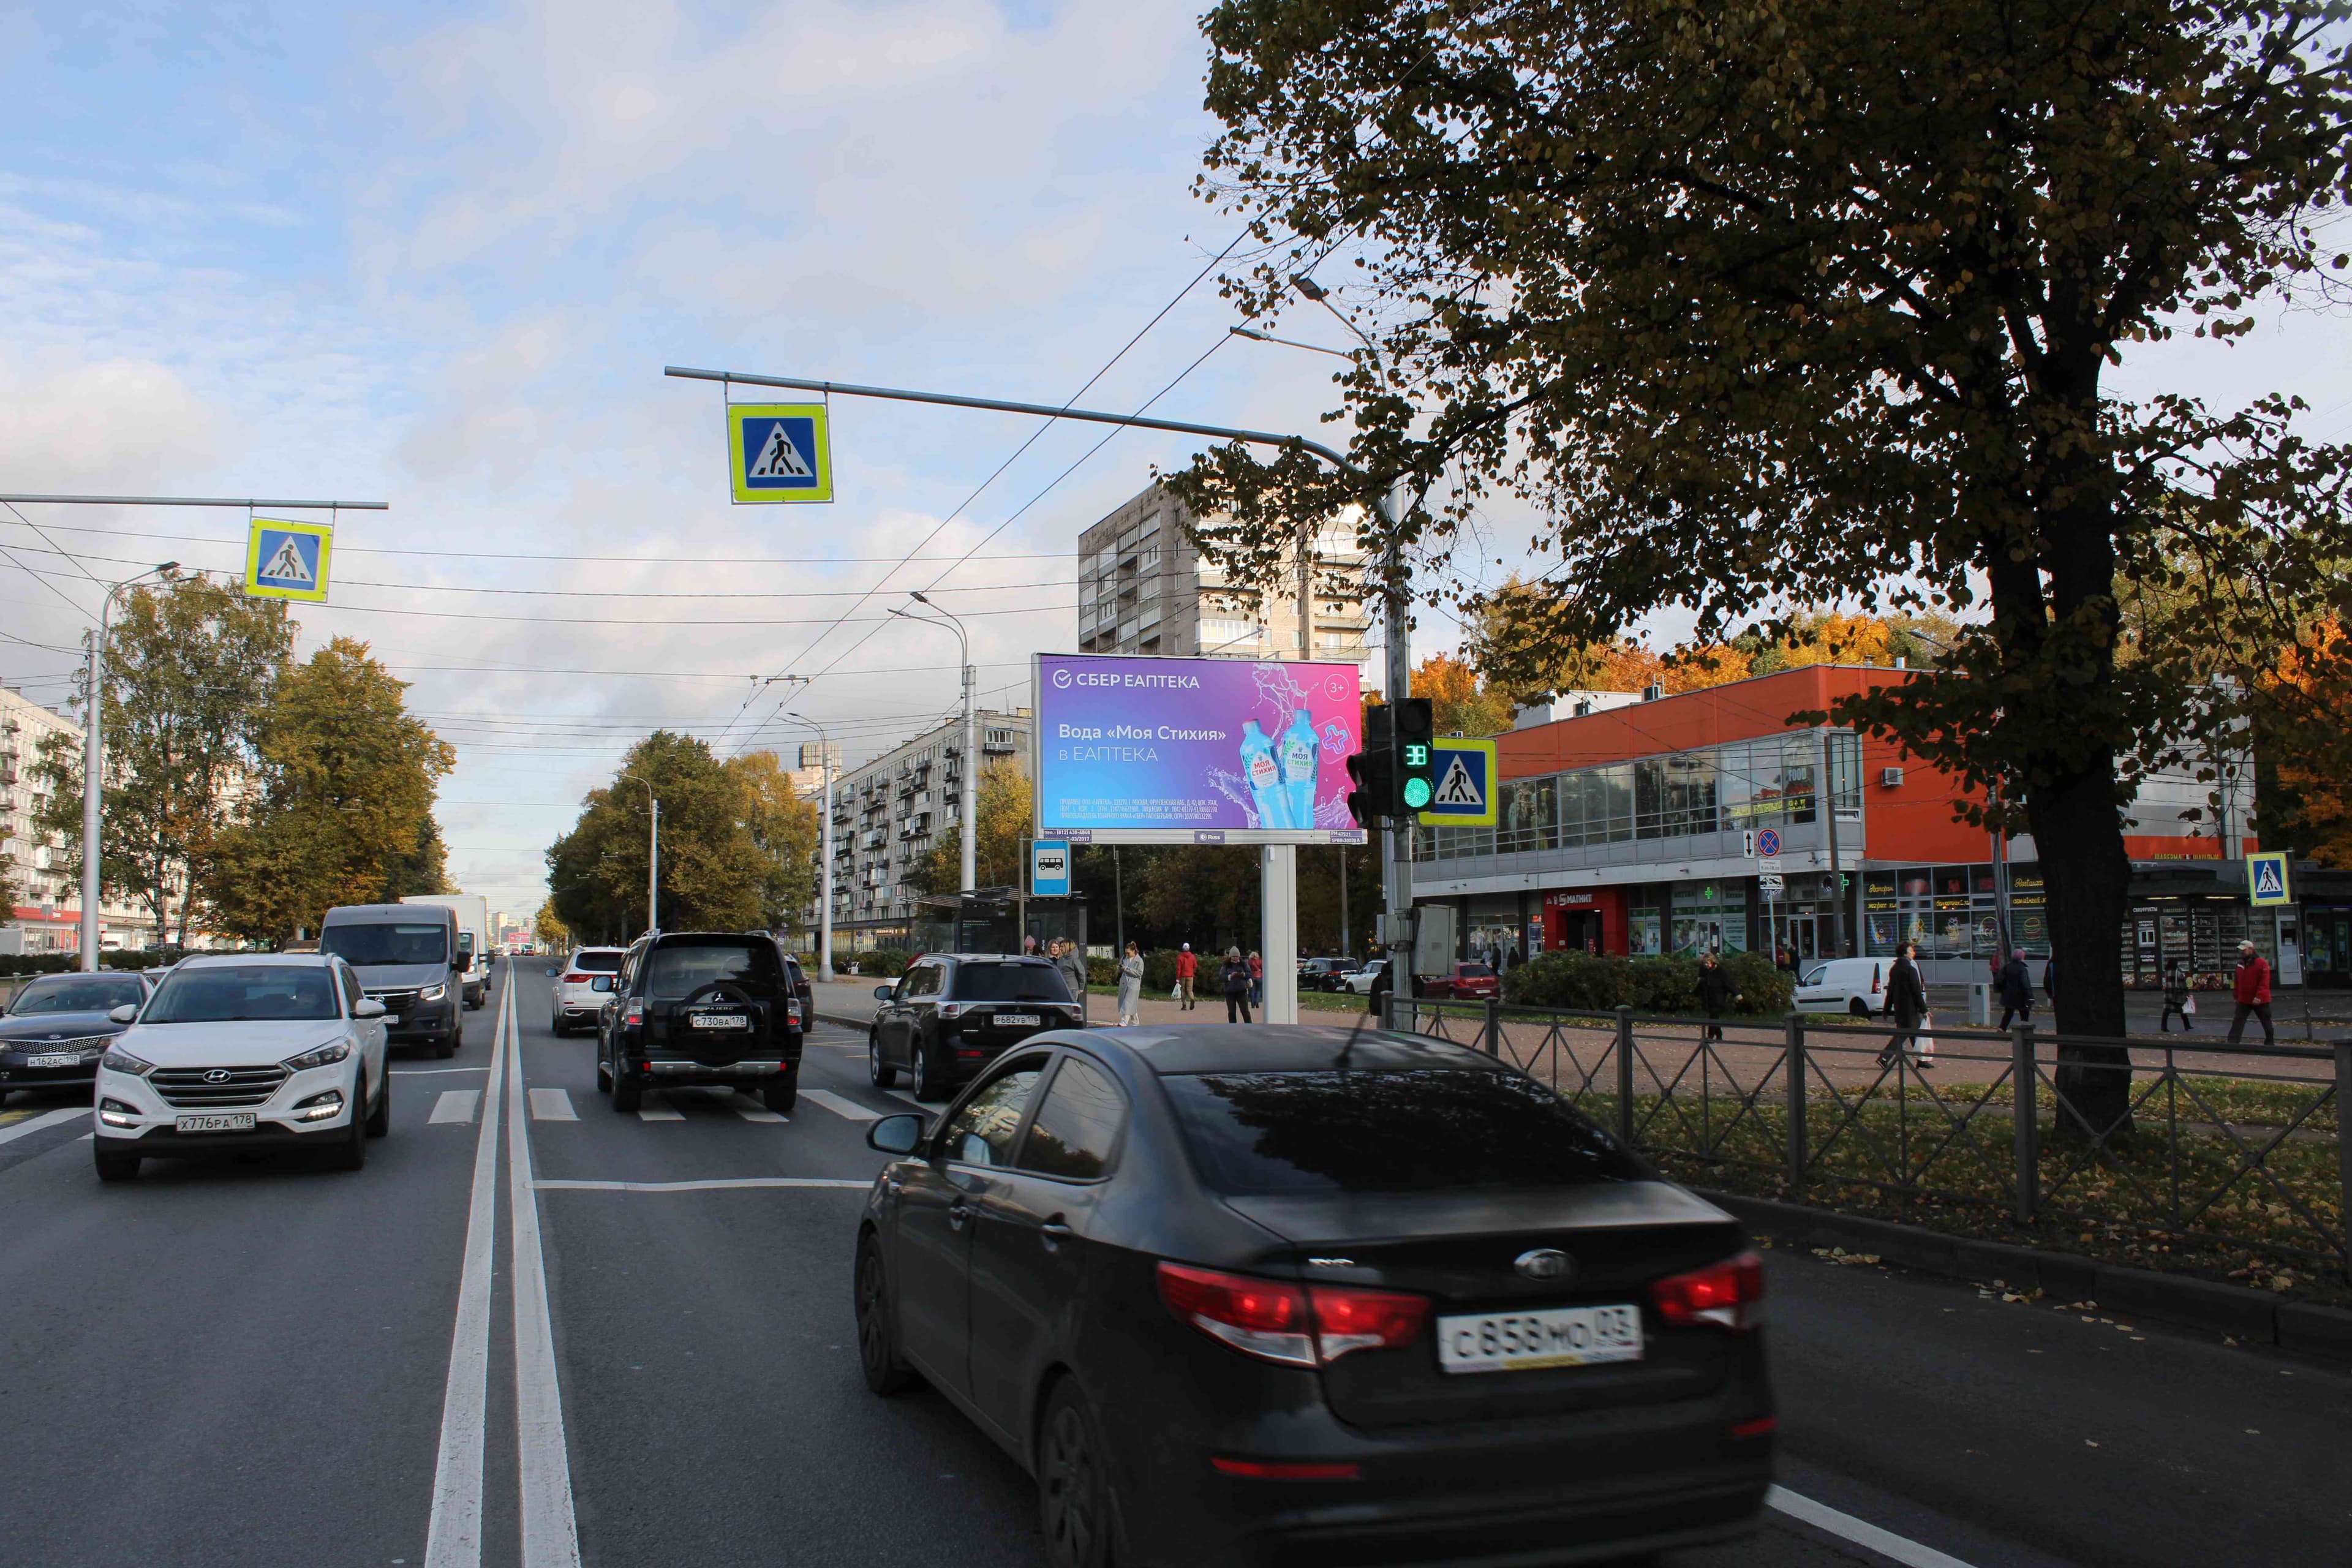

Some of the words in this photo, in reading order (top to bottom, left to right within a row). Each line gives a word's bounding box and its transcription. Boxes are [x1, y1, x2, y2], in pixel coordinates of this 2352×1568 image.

[1076, 674, 1120, 687] СБЕР
[1125, 674, 1200, 688] ЕАПТЕКА
[1330, 682, 1344, 693] 3+
[1059, 724, 1101, 741] Вода
[1107, 725, 1152, 739] «Моя
[1158, 726, 1226, 741] Стихия»
[1059, 750, 1068, 760] в
[1074, 747, 1158, 762] ЕАПТЕКА
[1406, 745, 1426, 765] 38
[1251, 765, 1276, 777] СТИХИЯ
[1254, 760, 1270, 769] МОЯ
[1789, 768, 1806, 781] FOOD
[1567, 894, 1593, 903] МАГНИТ
